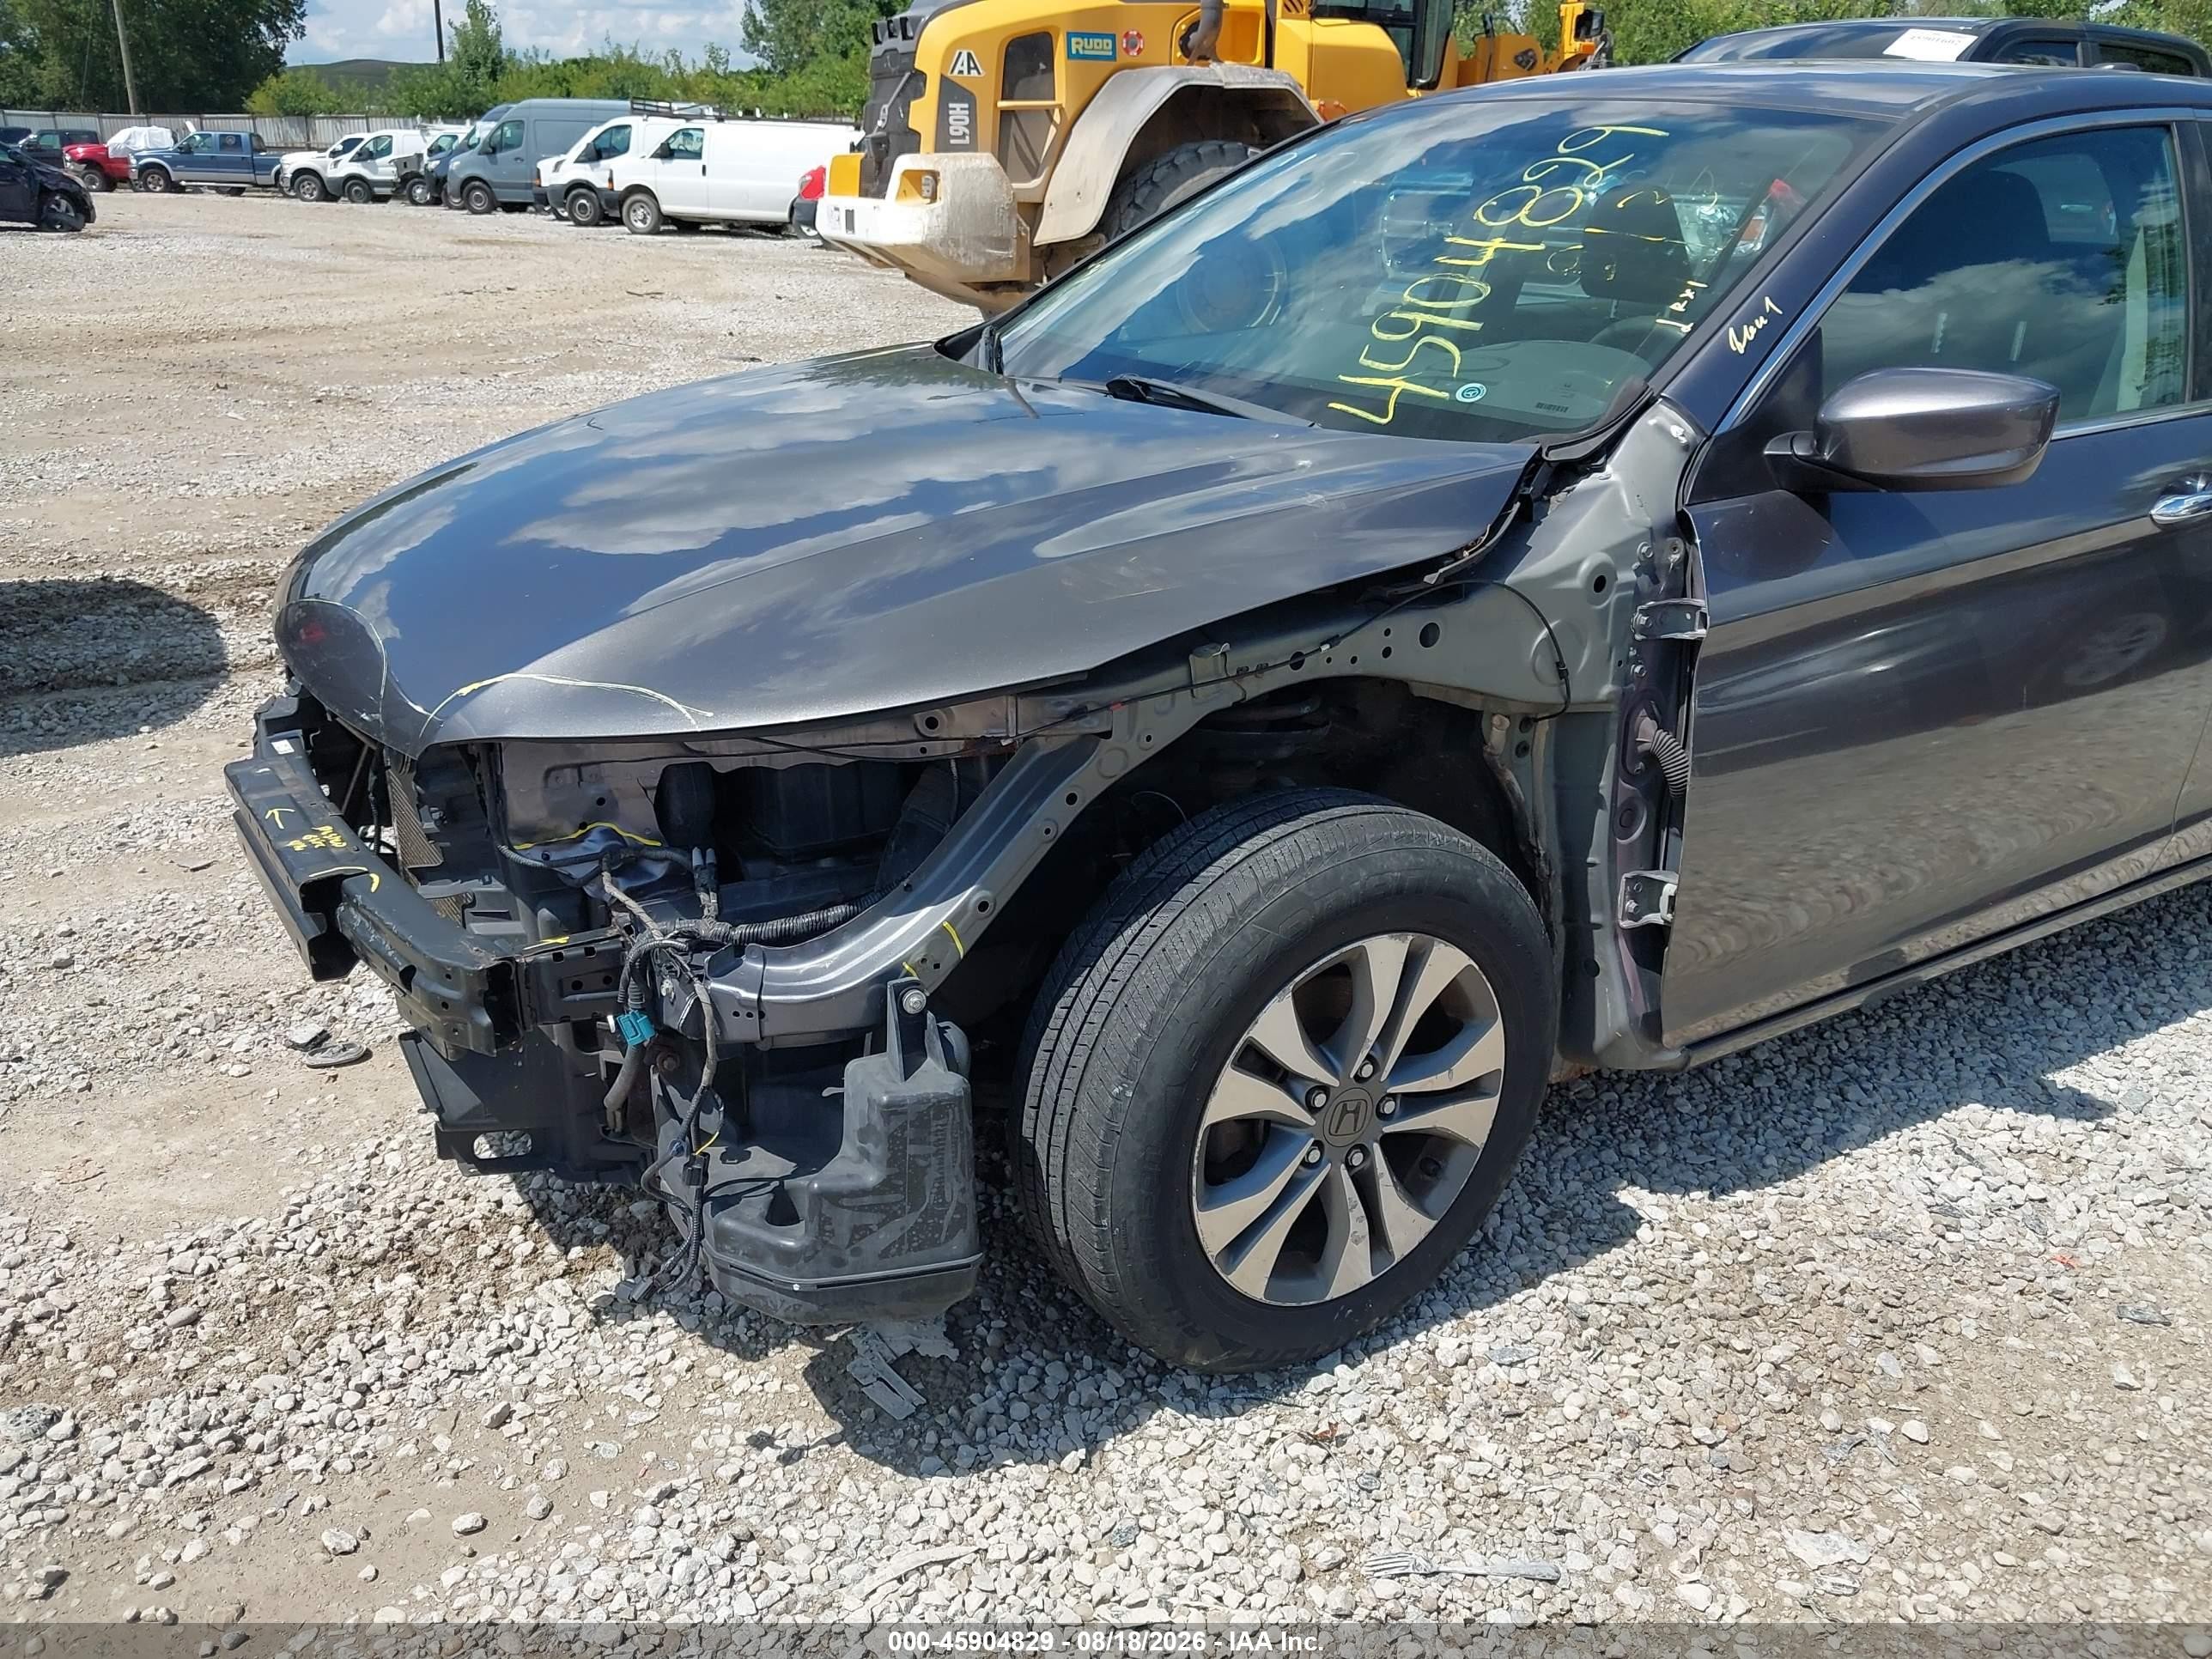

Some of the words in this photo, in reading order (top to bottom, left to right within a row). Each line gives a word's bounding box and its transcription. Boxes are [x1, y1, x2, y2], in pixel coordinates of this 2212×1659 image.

[1071, 37, 1113, 55] RUDD
[948, 103, 970, 144] L90H
[1328, 126, 1669, 424] 45904829
